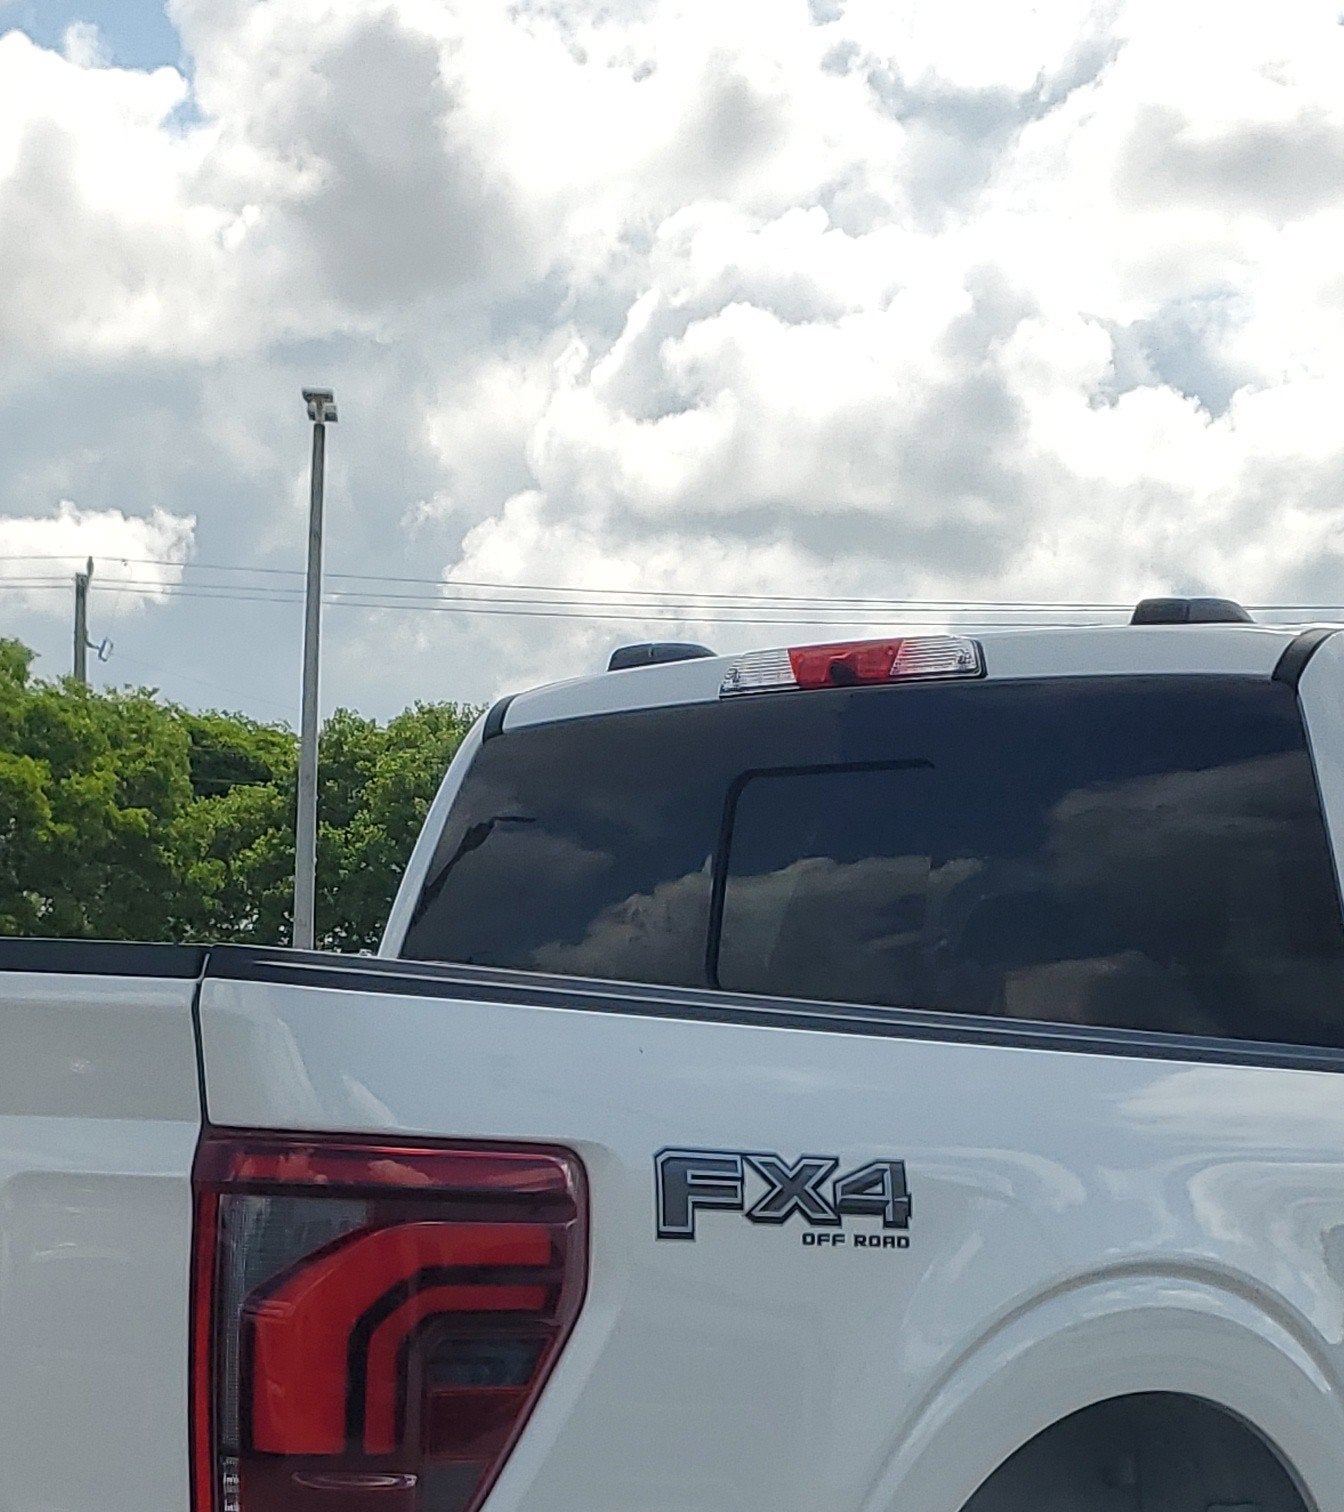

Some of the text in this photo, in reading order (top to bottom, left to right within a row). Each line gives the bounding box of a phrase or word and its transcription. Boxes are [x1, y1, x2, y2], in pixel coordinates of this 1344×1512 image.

[654, 1148, 912, 1240] FX4
[801, 1232, 911, 1249] OFF ROAD
